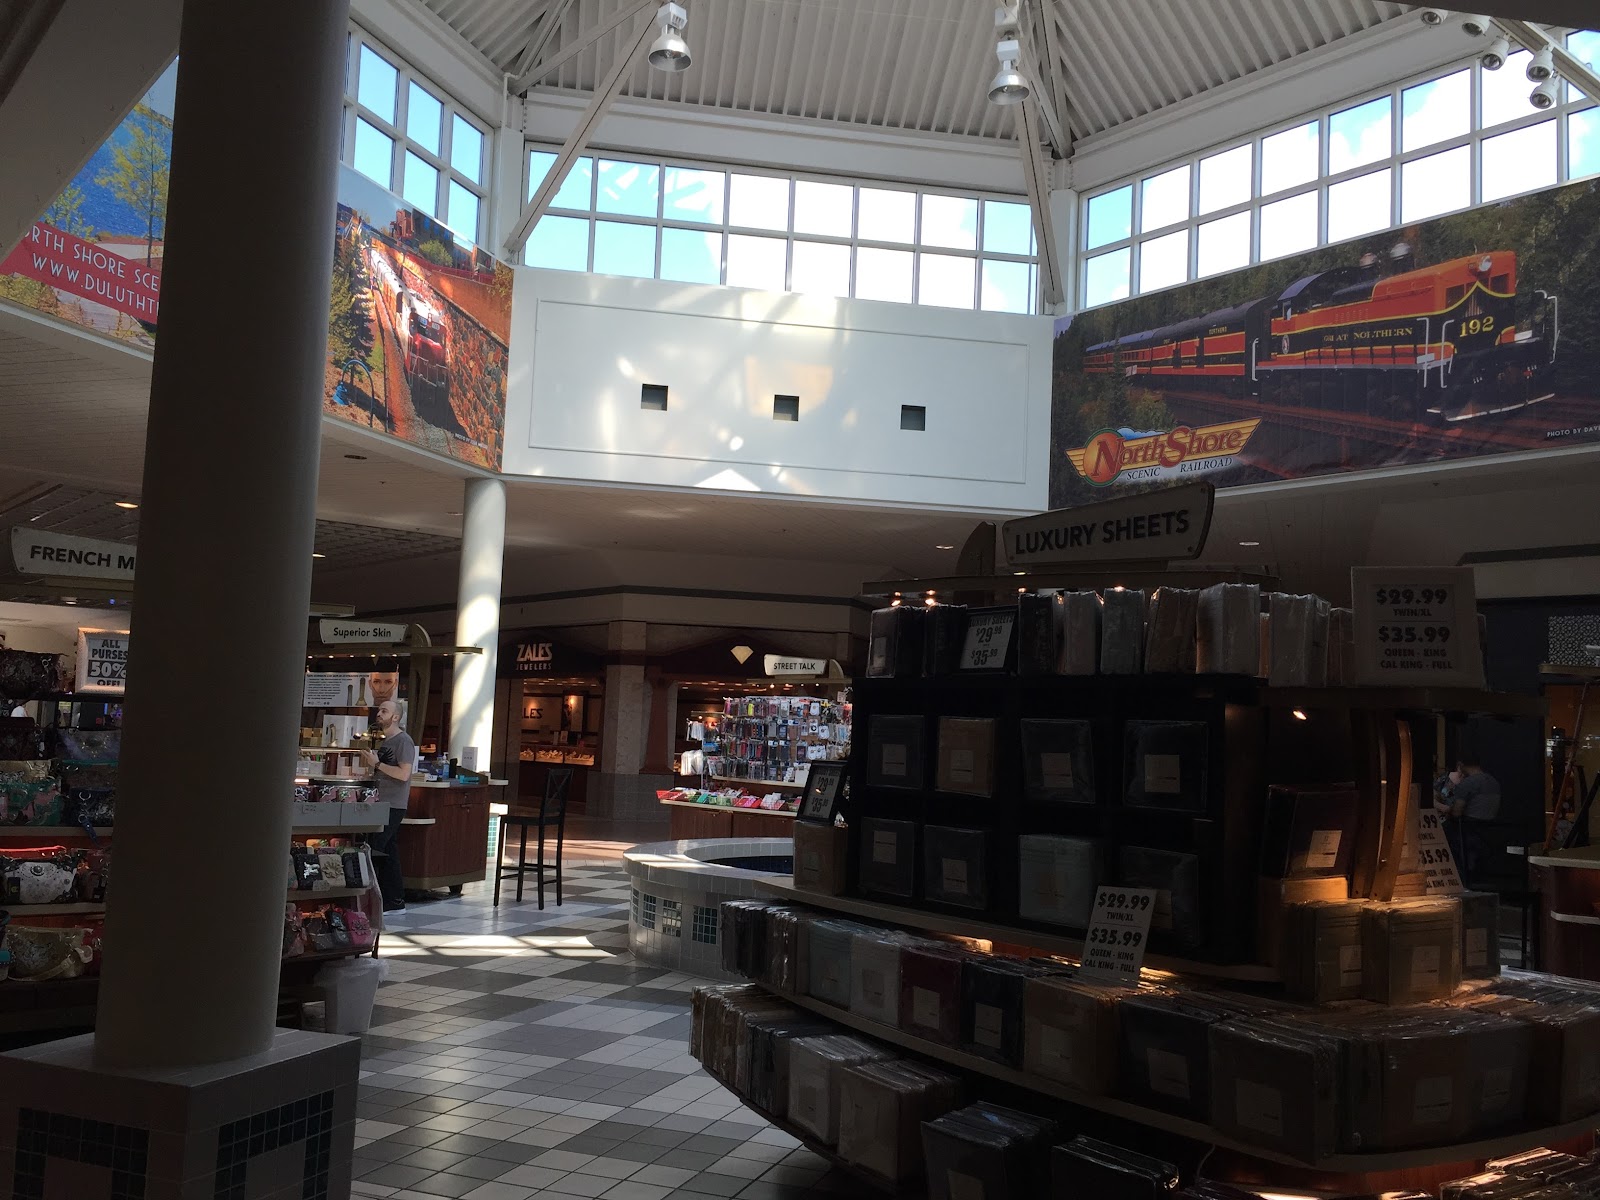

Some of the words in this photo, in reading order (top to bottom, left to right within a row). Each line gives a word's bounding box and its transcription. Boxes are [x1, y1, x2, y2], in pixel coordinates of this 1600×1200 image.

[25, 225, 65, 254] RTH
[73, 243, 126, 279] SHORE
[1459, 315, 1495, 338] 192
[1546, 429, 1570, 438] PHOTO
[1126, 466, 1161, 480] SCENIC
[1180, 456, 1233, 473] RAILROAD
[1015, 522, 1097, 555] LUXURY
[1102, 509, 1190, 543] SHEETS
[30, 545, 111, 568] FRENCH
[1376, 588, 1447, 605] $29.99
[333, 627, 371, 638] Superior
[373, 627, 392, 638] Skin
[1378, 625, 1450, 643] $35.99
[101, 639, 121, 648] ALL
[516, 643, 552, 661] ZALES
[92, 648, 129, 660] PURSES
[90, 661, 127, 678] 50%
[515, 662, 552, 671] JEWELERS
[774, 662, 797, 670] STREET
[799, 662, 816, 670] TALK
[1097, 891, 1150, 911] $29.99
[1106, 911, 1135, 921] TWIN/XL
[1090, 927, 1143, 948] $35.99
[1090, 948, 1112, 958] QUEEN
[1117, 951, 1135, 961] KING
[1084, 959, 1096, 968] CAL
[1097, 960, 1115, 970] KING
[1120, 963, 1136, 973] FULL
